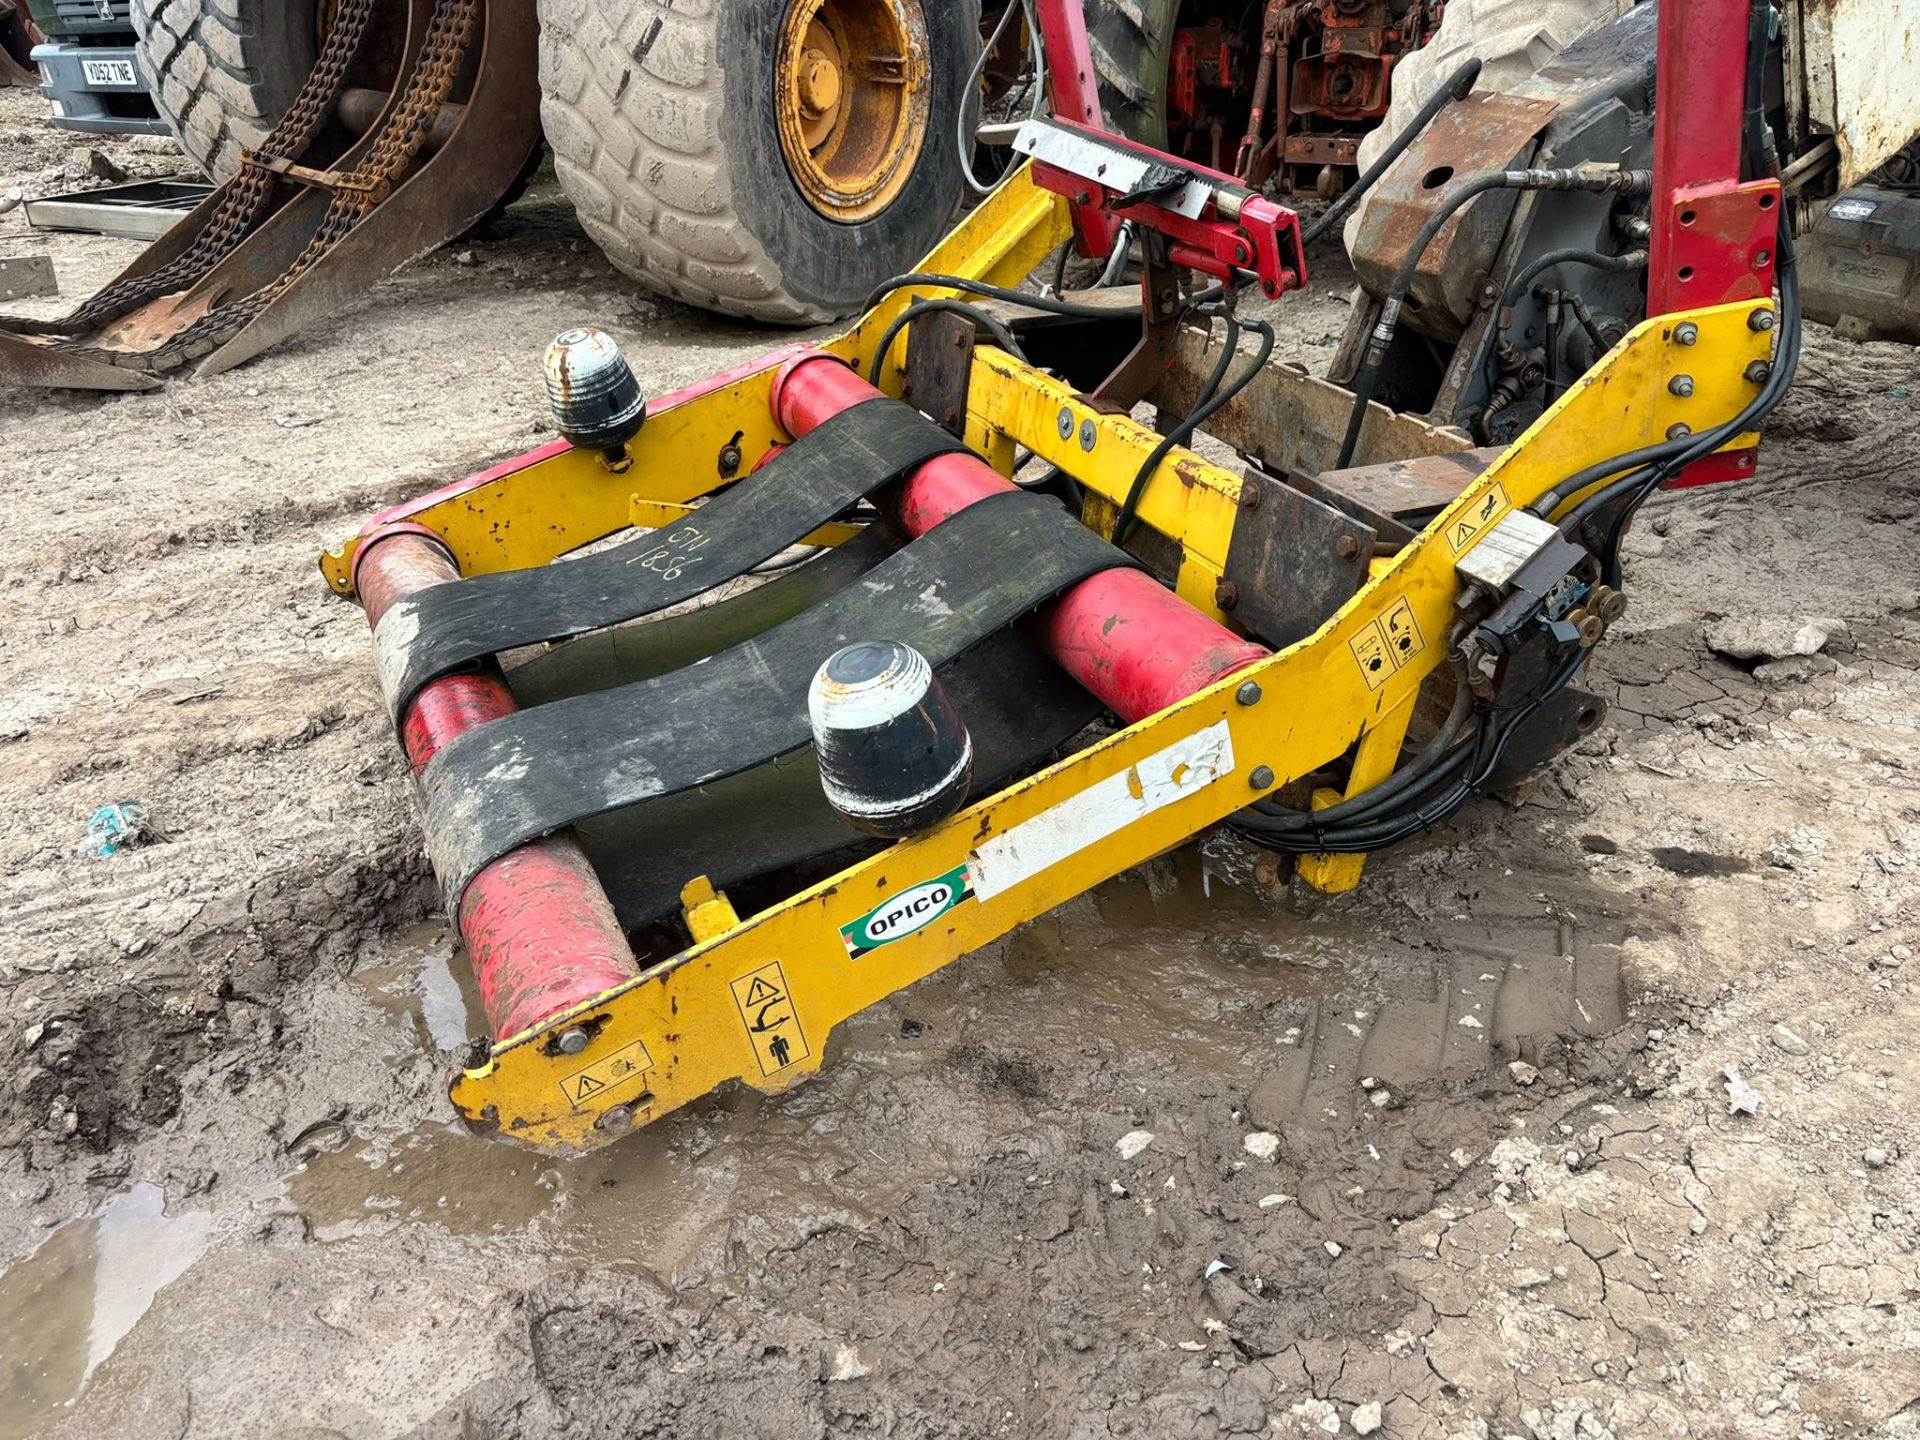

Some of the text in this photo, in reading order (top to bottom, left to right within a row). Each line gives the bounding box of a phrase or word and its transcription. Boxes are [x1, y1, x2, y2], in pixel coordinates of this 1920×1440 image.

[87, 63, 132, 80] YD52 TNE
[626, 544, 703, 580] 1856
[870, 887, 948, 936] OPICO
